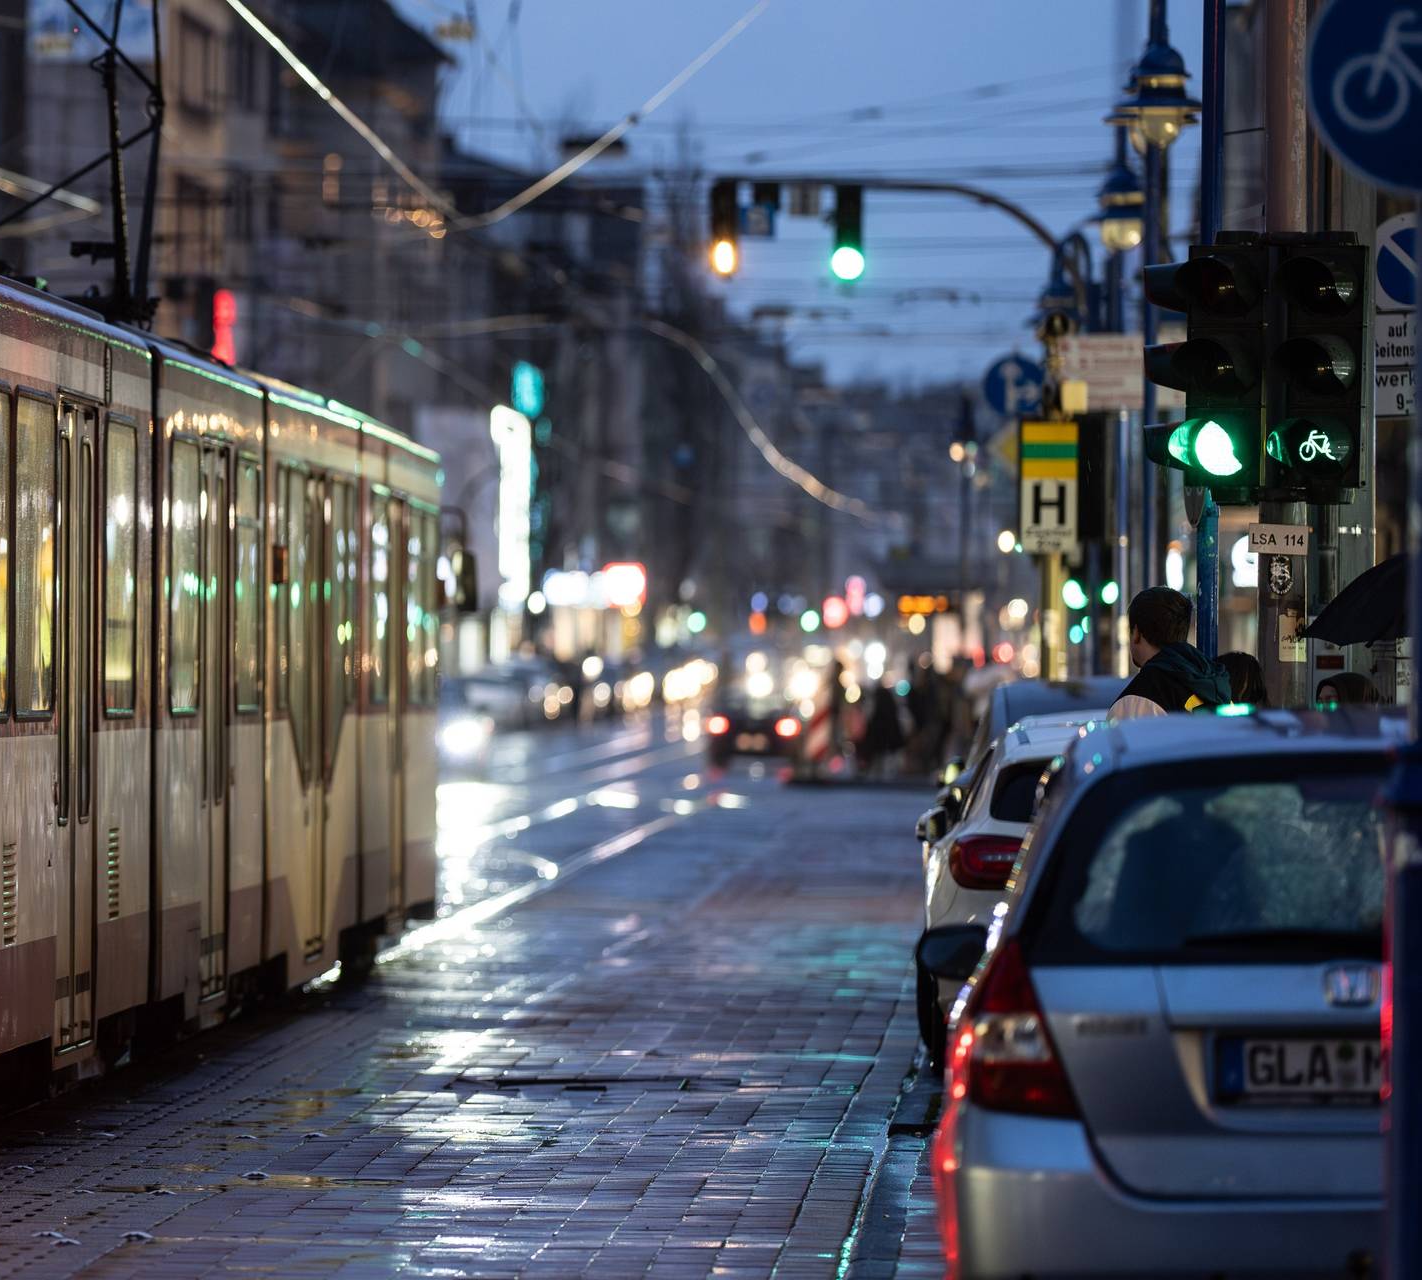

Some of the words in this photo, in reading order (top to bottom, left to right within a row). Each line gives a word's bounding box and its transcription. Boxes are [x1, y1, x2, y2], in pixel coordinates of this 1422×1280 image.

[1388, 322, 1407, 337] auf
[1033, 484, 1066, 525] H
[1251, 533, 1277, 546] LSA
[1284, 534, 1305, 547] 114
[1248, 1043, 1333, 1086] GLA
